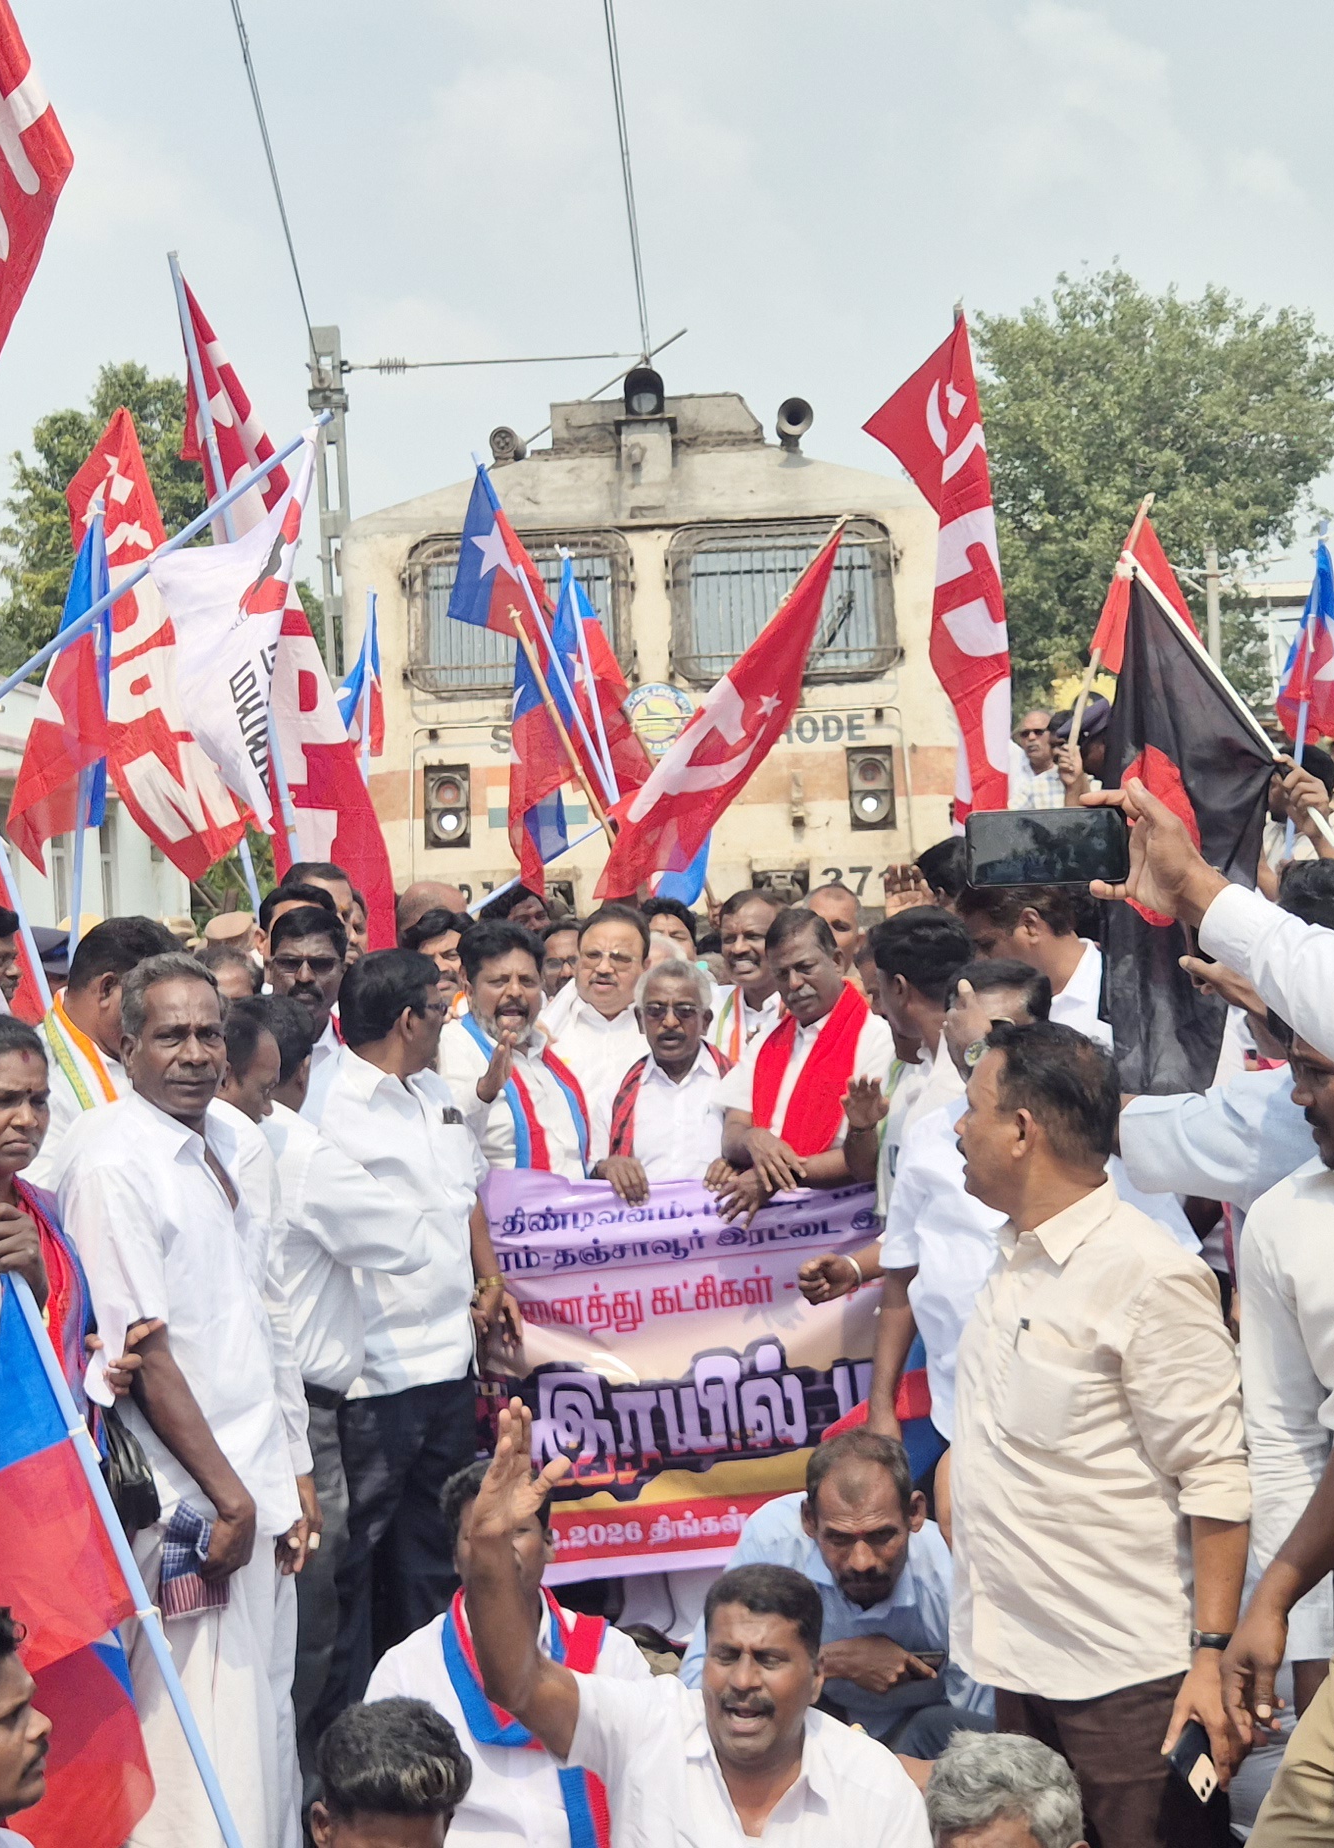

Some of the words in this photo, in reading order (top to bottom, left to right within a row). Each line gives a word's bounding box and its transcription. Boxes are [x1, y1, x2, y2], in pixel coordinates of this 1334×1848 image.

[490, 1200, 693, 1238] -திண்டிவனம்.
[497, 1227, 708, 1272] ரம்-தஞ்சாவூர்
[716, 1217, 843, 1247] இரட்டை
[520, 1282, 645, 1334] னைத்து
[651, 1264, 774, 1316] கட்சிகள்
[530, 1343, 809, 1480] இரயில்
